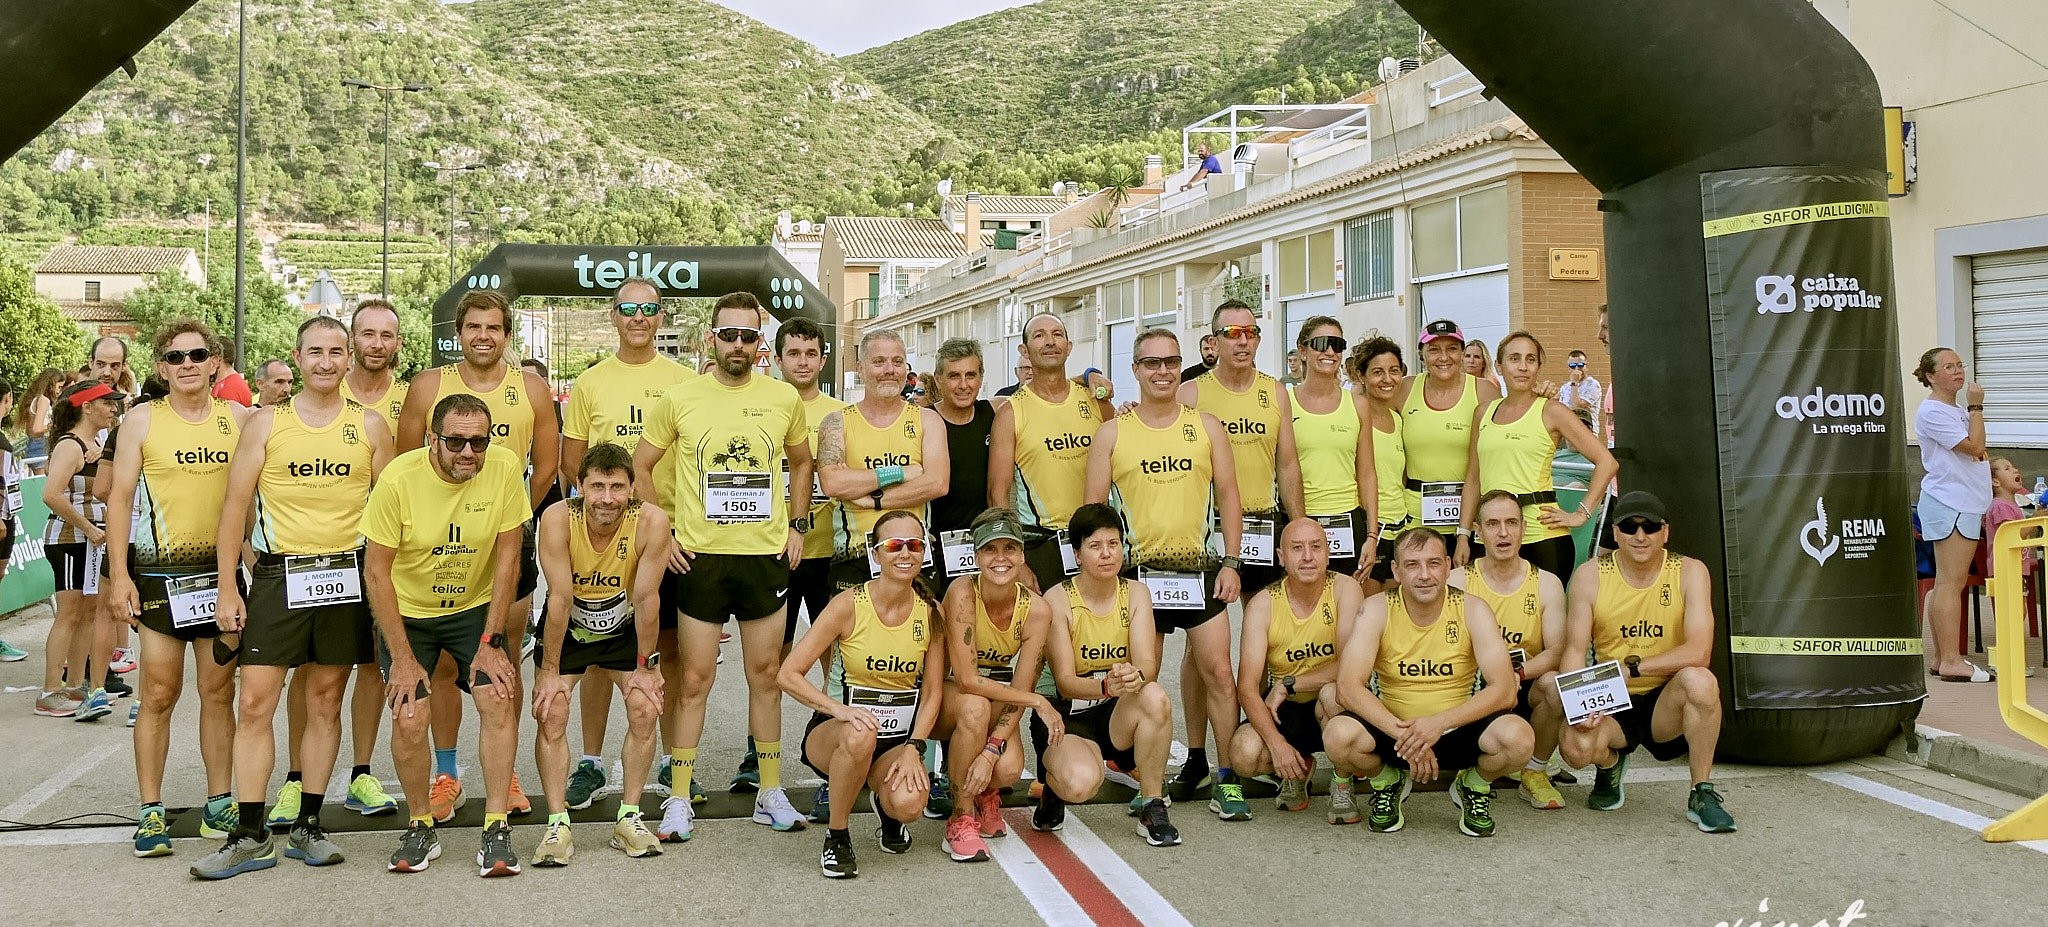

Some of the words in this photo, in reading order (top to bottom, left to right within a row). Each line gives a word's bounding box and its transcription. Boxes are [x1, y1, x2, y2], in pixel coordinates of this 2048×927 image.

[1763, 209, 1811, 225] SAFOR
[1815, 203, 1875, 218] VALLDIGNA
[574, 251, 698, 290] teika
[1802, 274, 1859, 292] caixa
[1803, 291, 1881, 312] popular
[437, 336, 463, 351] tei
[1775, 386, 1885, 421] adamo
[1813, 423, 1828, 434] La
[1830, 424, 1862, 436] mega
[1863, 422, 1885, 433] fibra
[1044, 433, 1091, 451] teika
[175, 447, 228, 464] teika
[864, 453, 910, 469] teika
[288, 458, 350, 477] teika
[1140, 456, 1192, 474] teika
[722, 501, 757, 512] 1505
[1435, 507, 1459, 517] 160
[1842, 519, 1886, 537] REMA
[445, 548, 478, 556] popular
[1242, 546, 1259, 556] 45
[1327, 540, 1341, 550] 75
[5, 533, 46, 575] opular
[959, 556, 974, 567] 20
[572, 571, 620, 587] teika
[305, 583, 344, 597] 1990
[432, 584, 466, 594] teika
[1154, 590, 1189, 601] 1548
[189, 601, 216, 616] 110
[582, 616, 616, 628] 1107
[1620, 620, 1663, 638] teika
[1081, 643, 1127, 660] teika
[1286, 642, 1335, 662] teika
[1792, 640, 1842, 652] SAFOR
[1846, 640, 1907, 652] VALLDIGNA
[977, 648, 1013, 662] eika
[866, 655, 918, 673] teika
[1398, 659, 1453, 676] teika
[1576, 683, 1610, 697] Fernando
[1580, 693, 1615, 711] 1354
[880, 718, 898, 729] 40
